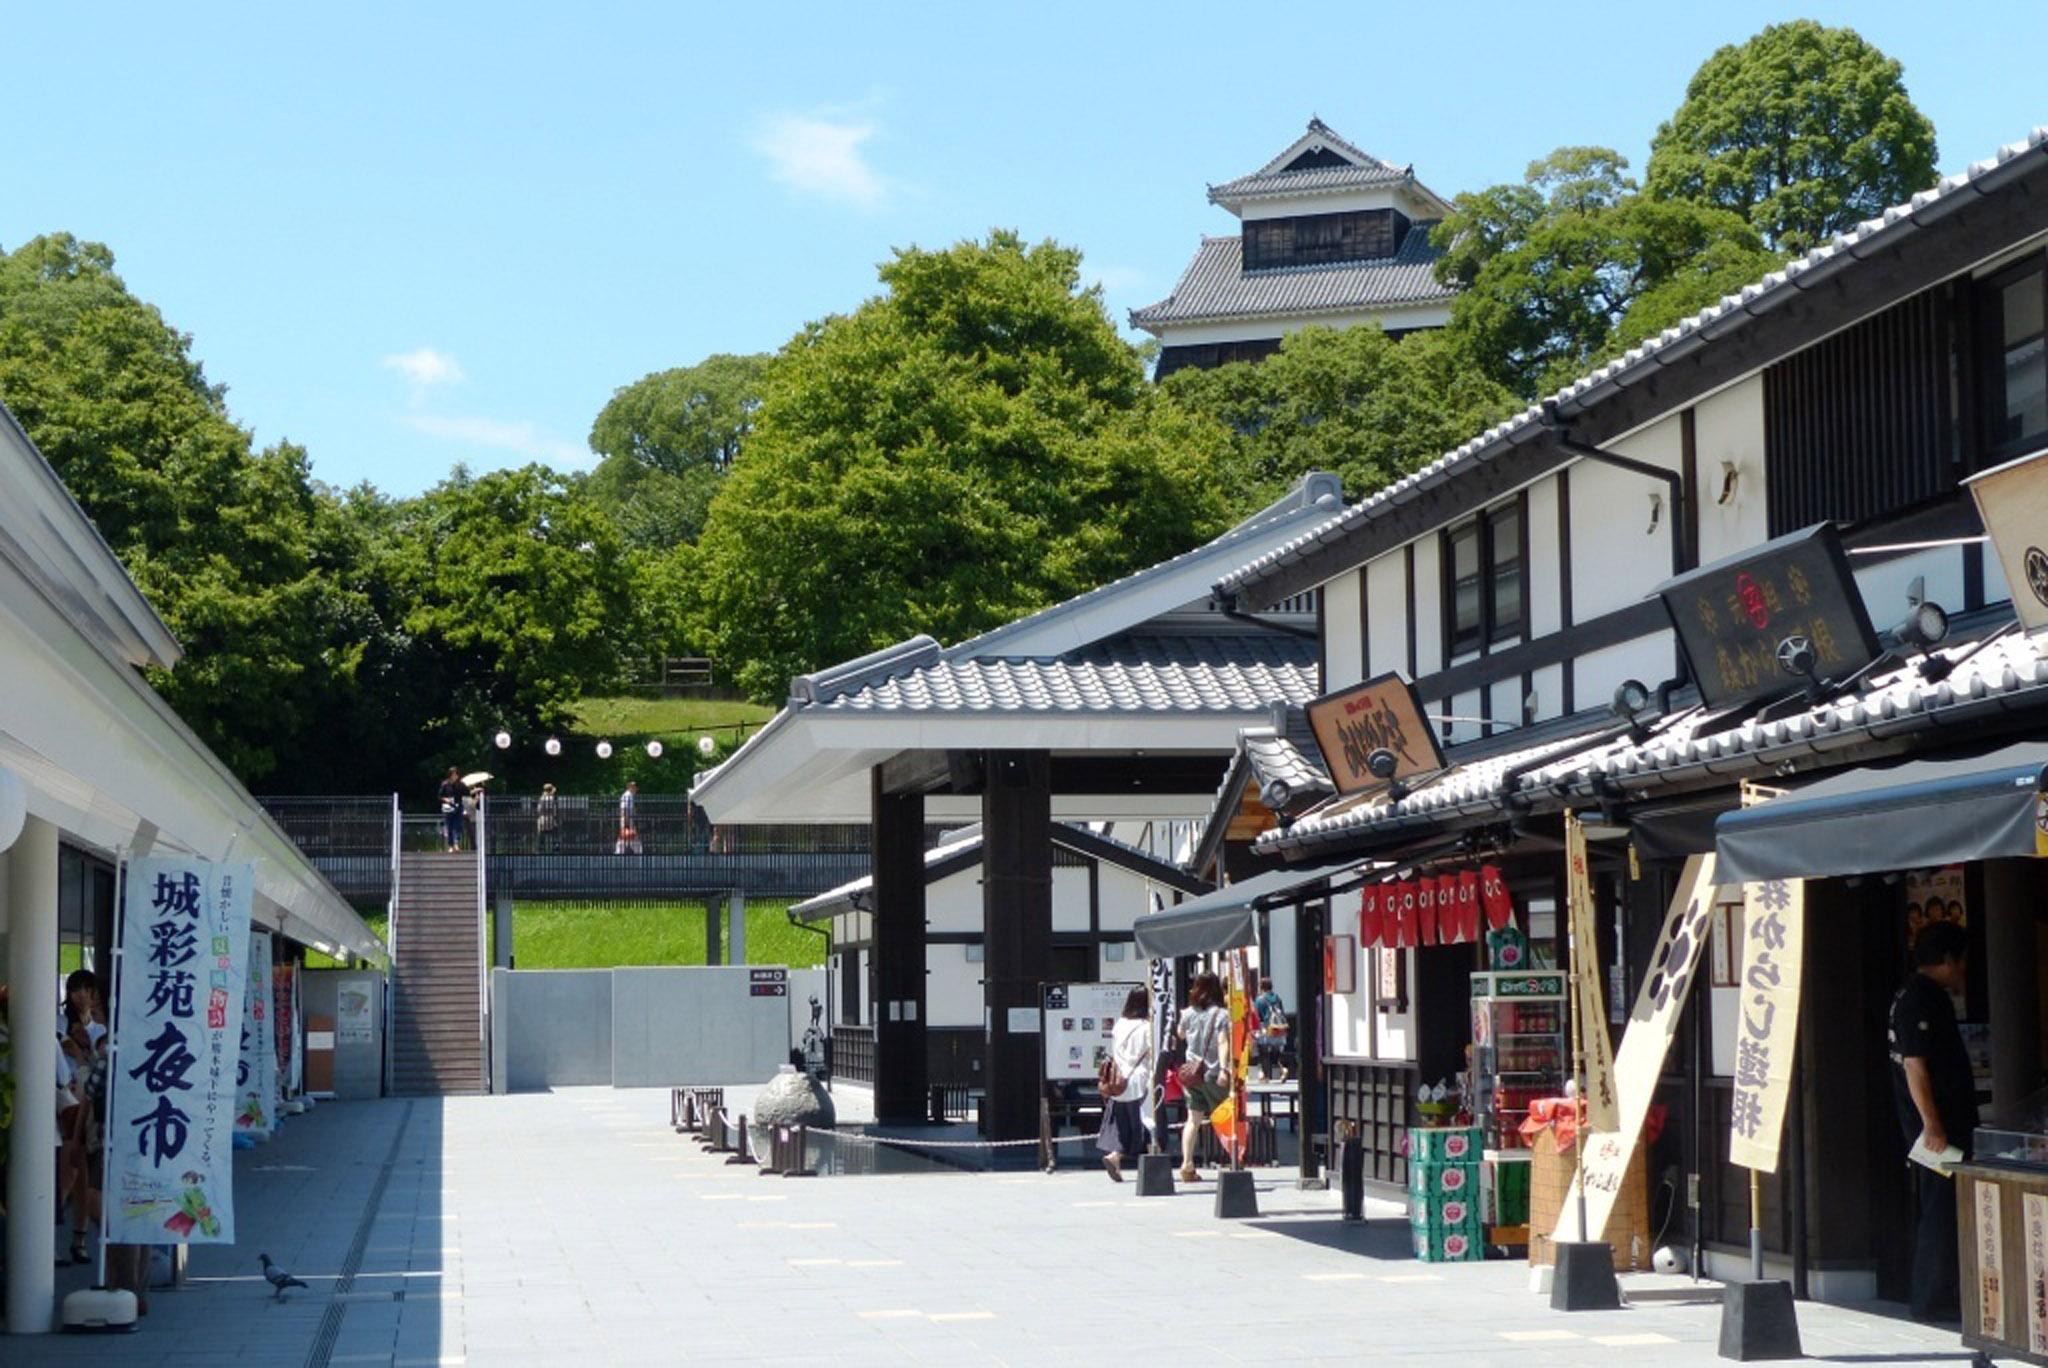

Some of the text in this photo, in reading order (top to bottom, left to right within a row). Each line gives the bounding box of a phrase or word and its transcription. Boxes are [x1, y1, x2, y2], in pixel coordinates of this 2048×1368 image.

[1716, 617, 1843, 690] 森からし根
[129, 872, 201, 1169] 城彩苑夜市
